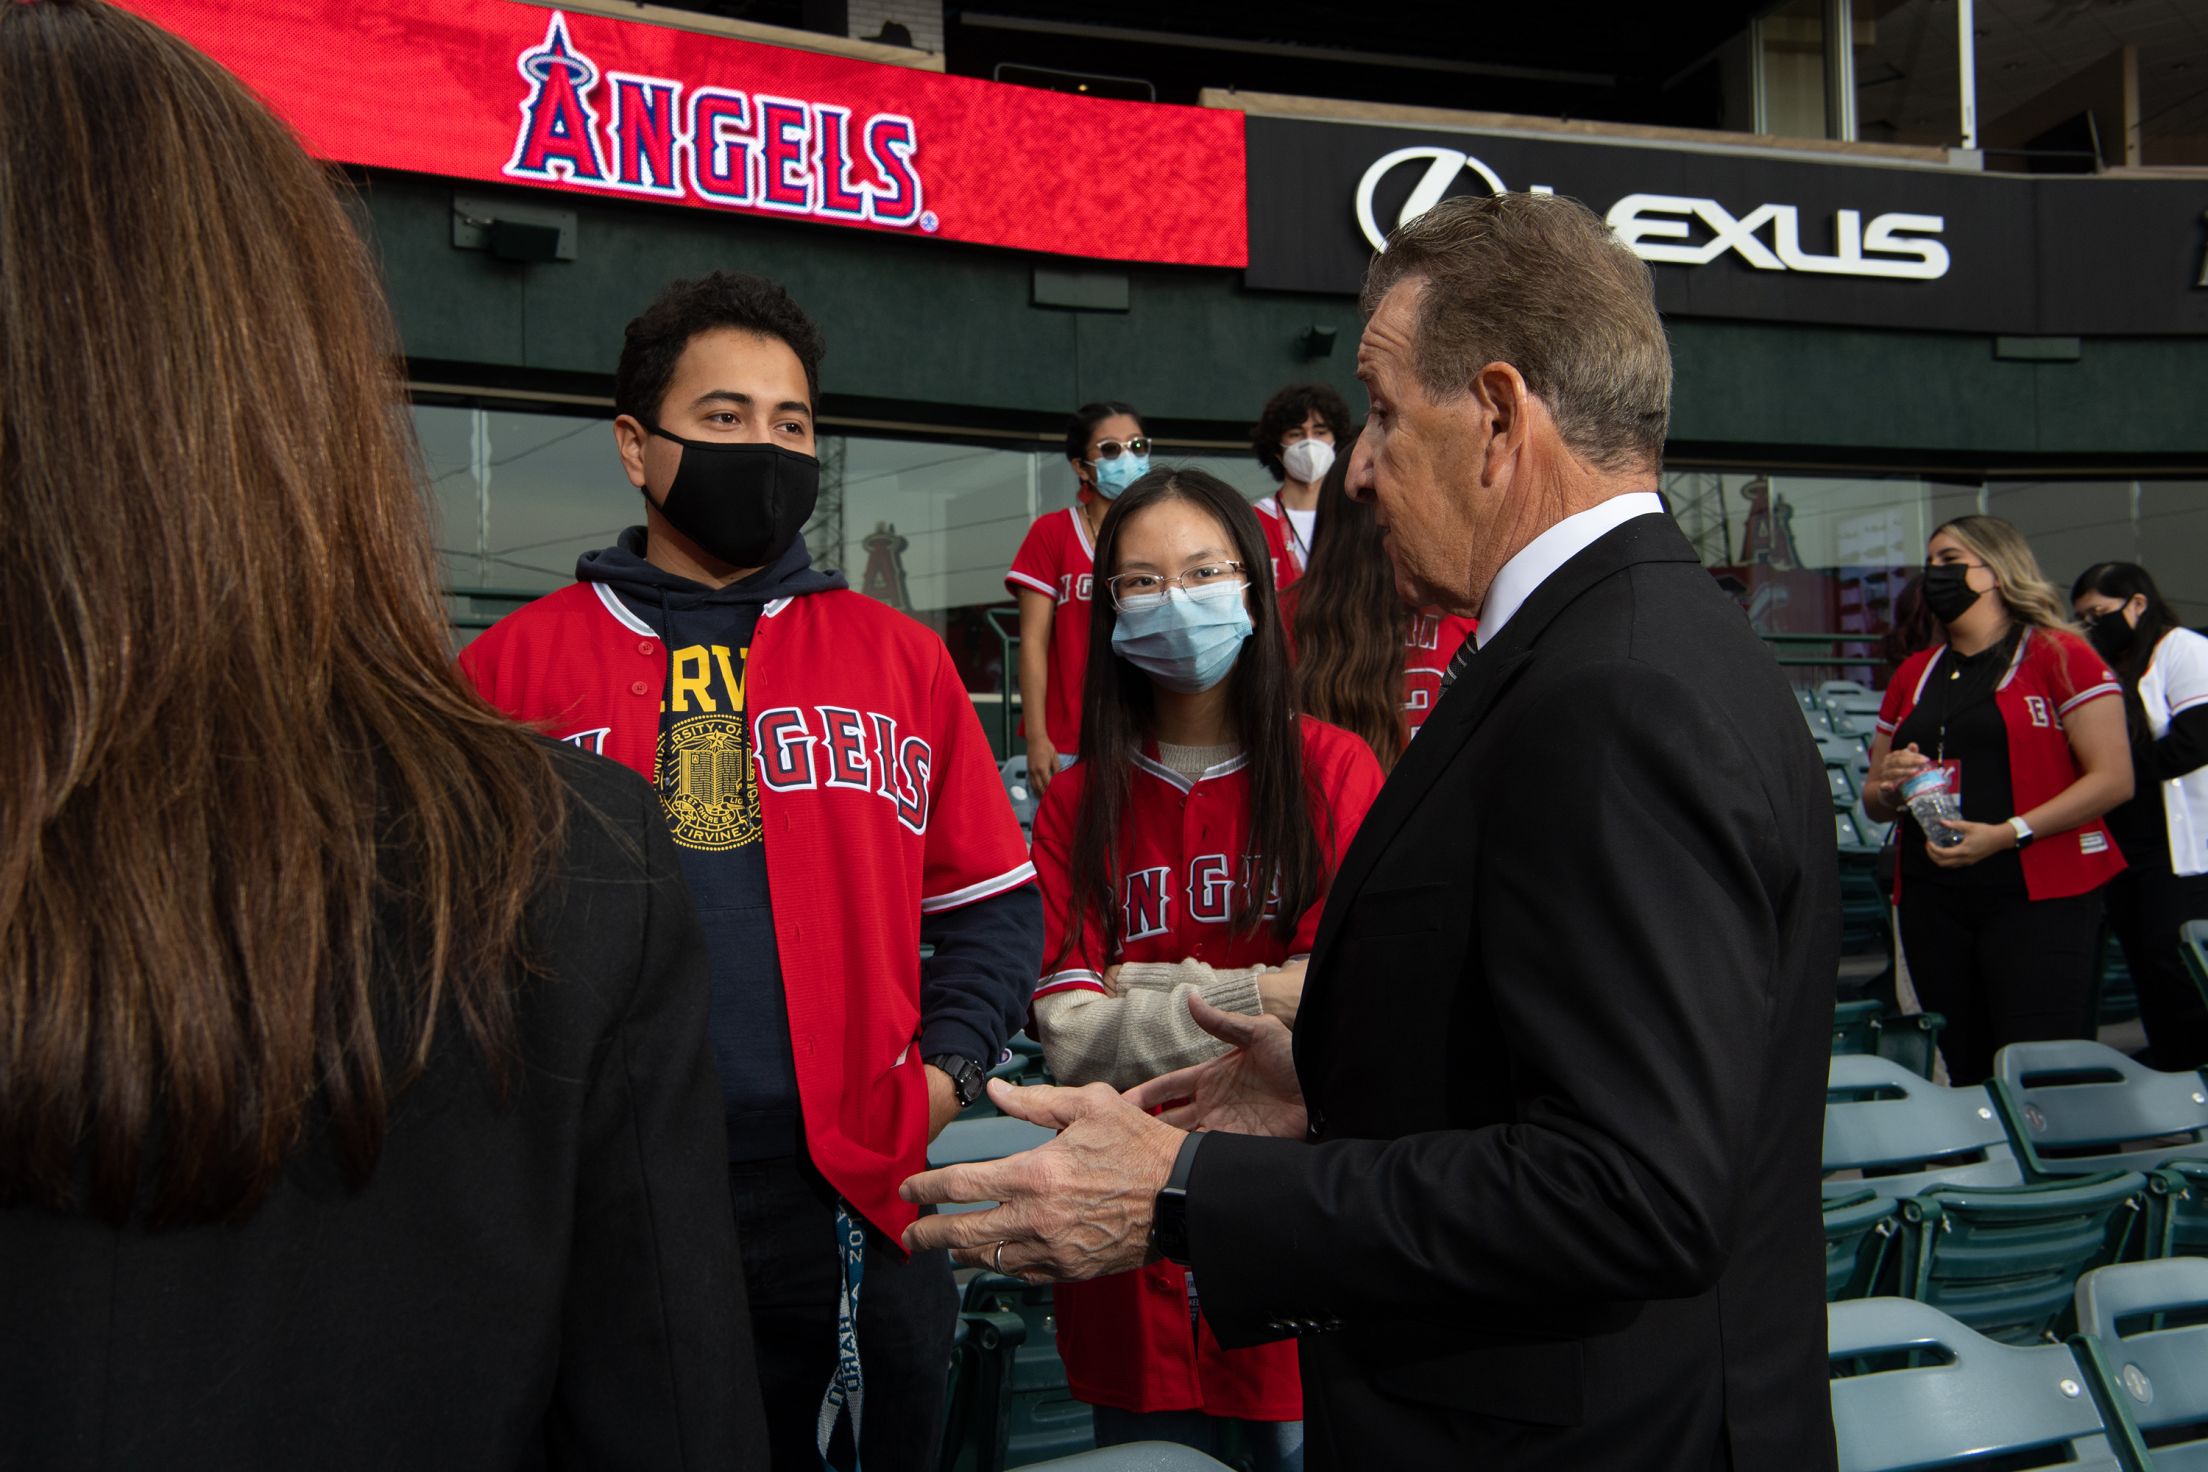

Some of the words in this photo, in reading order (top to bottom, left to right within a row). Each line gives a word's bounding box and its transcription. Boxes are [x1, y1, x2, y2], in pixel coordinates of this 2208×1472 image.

[501, 10, 925, 229] ANGELS
[1529, 184, 1950, 280] EXUS
[660, 644, 749, 713] RV
[687, 827, 742, 842] IRVINE
[721, 813, 734, 824] BE
